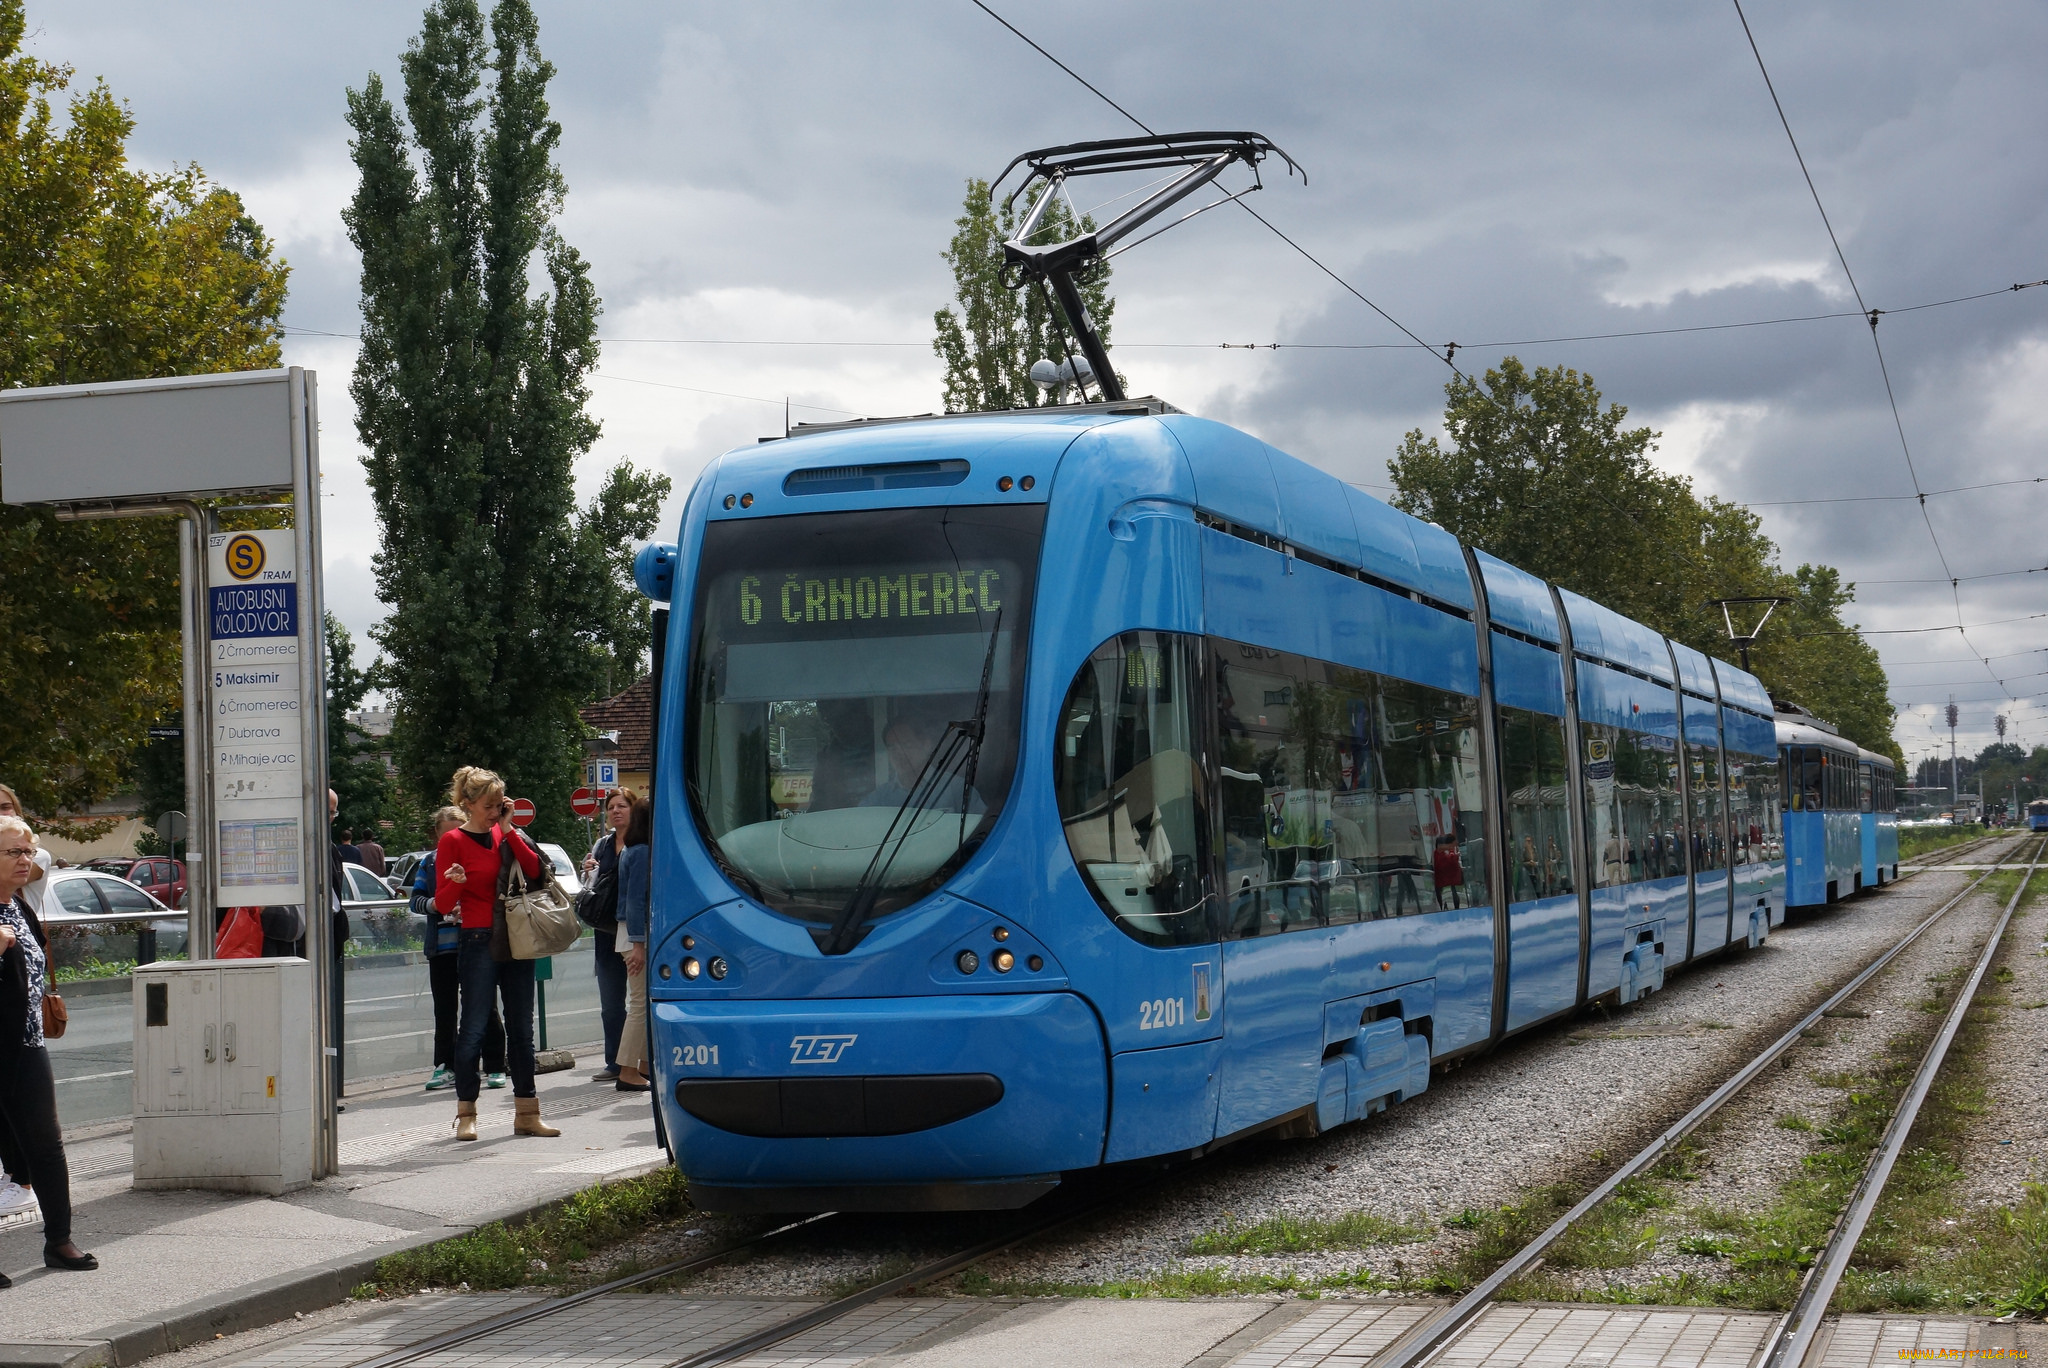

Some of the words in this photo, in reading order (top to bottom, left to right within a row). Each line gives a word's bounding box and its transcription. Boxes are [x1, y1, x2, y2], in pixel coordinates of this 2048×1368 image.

[235, 544, 253, 570] S
[263, 570, 291, 580] TRAM
[217, 588, 286, 612] AUTOBUSNI
[740, 576, 762, 624] 6
[781, 569, 1000, 623] ČRNOMEREC
[216, 611, 290, 634] KOLODVOR
[218, 644, 225, 660] 2
[226, 644, 297, 658] Črnomerec
[215, 672, 222, 688] 5
[226, 671, 280, 685] Maksimir
[218, 700, 226, 715] 6
[227, 698, 298, 712] Črnomerec
[218, 726, 225, 741] 7
[228, 727, 280, 739] Dubrava
[603, 767, 612, 781] P
[1139, 997, 1185, 1030] 2201
[672, 1044, 720, 1066] 2201
